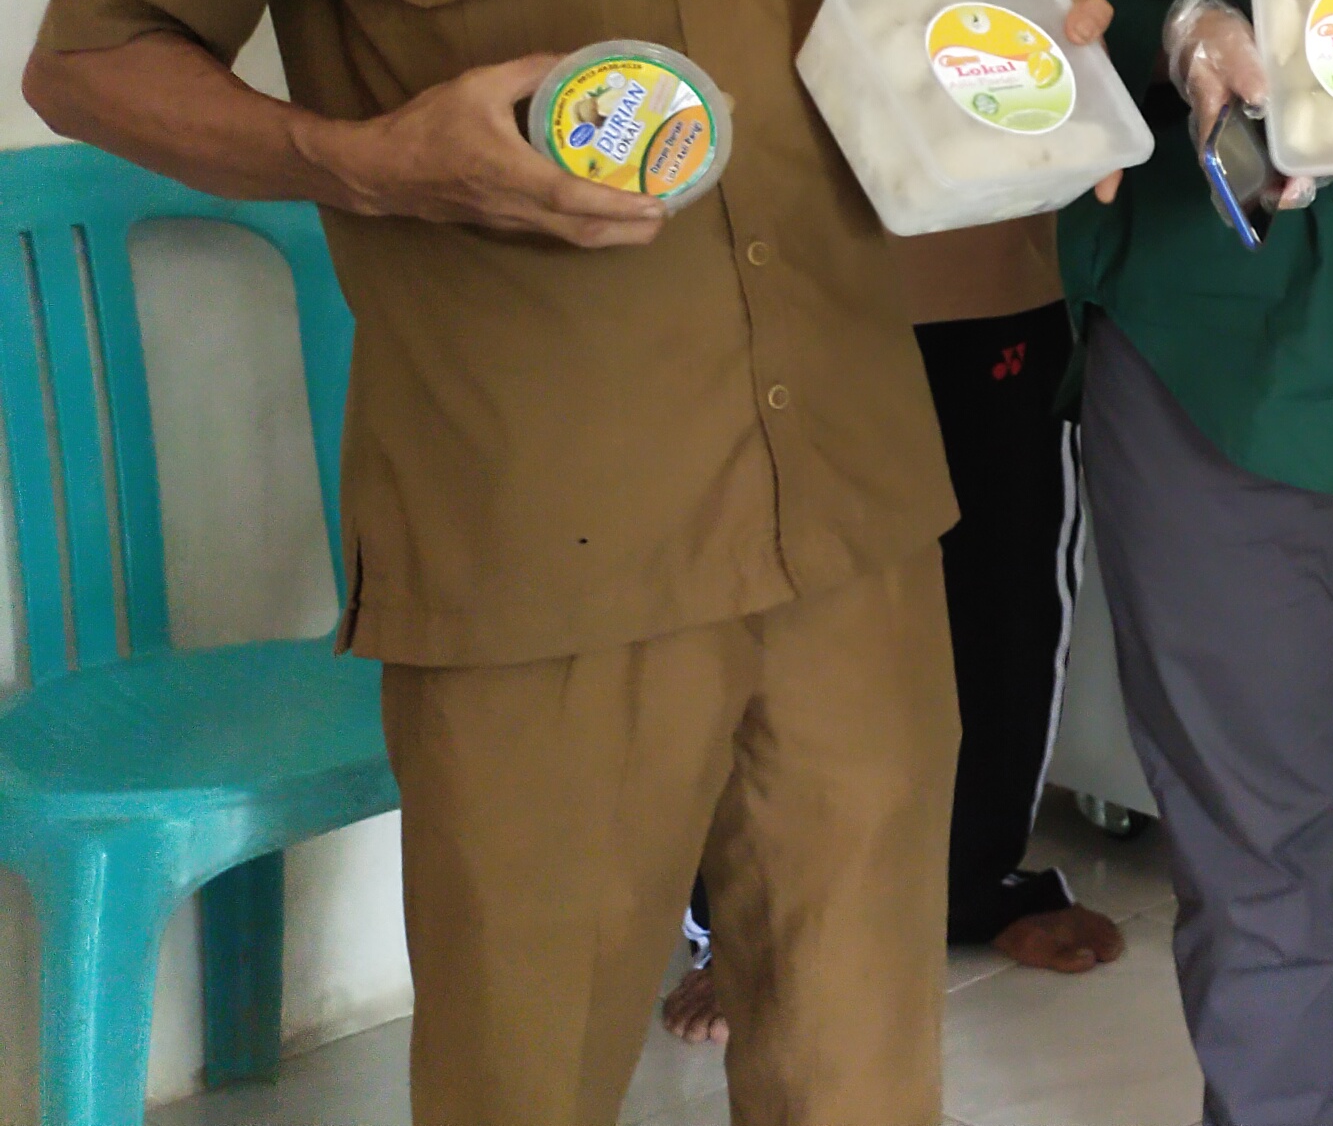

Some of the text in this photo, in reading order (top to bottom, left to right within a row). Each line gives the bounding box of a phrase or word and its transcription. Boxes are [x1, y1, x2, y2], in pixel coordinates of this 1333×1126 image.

[956, 61, 1017, 77] Lokal
[597, 82, 646, 154] DURIAN
[612, 121, 643, 162] LOKAL
